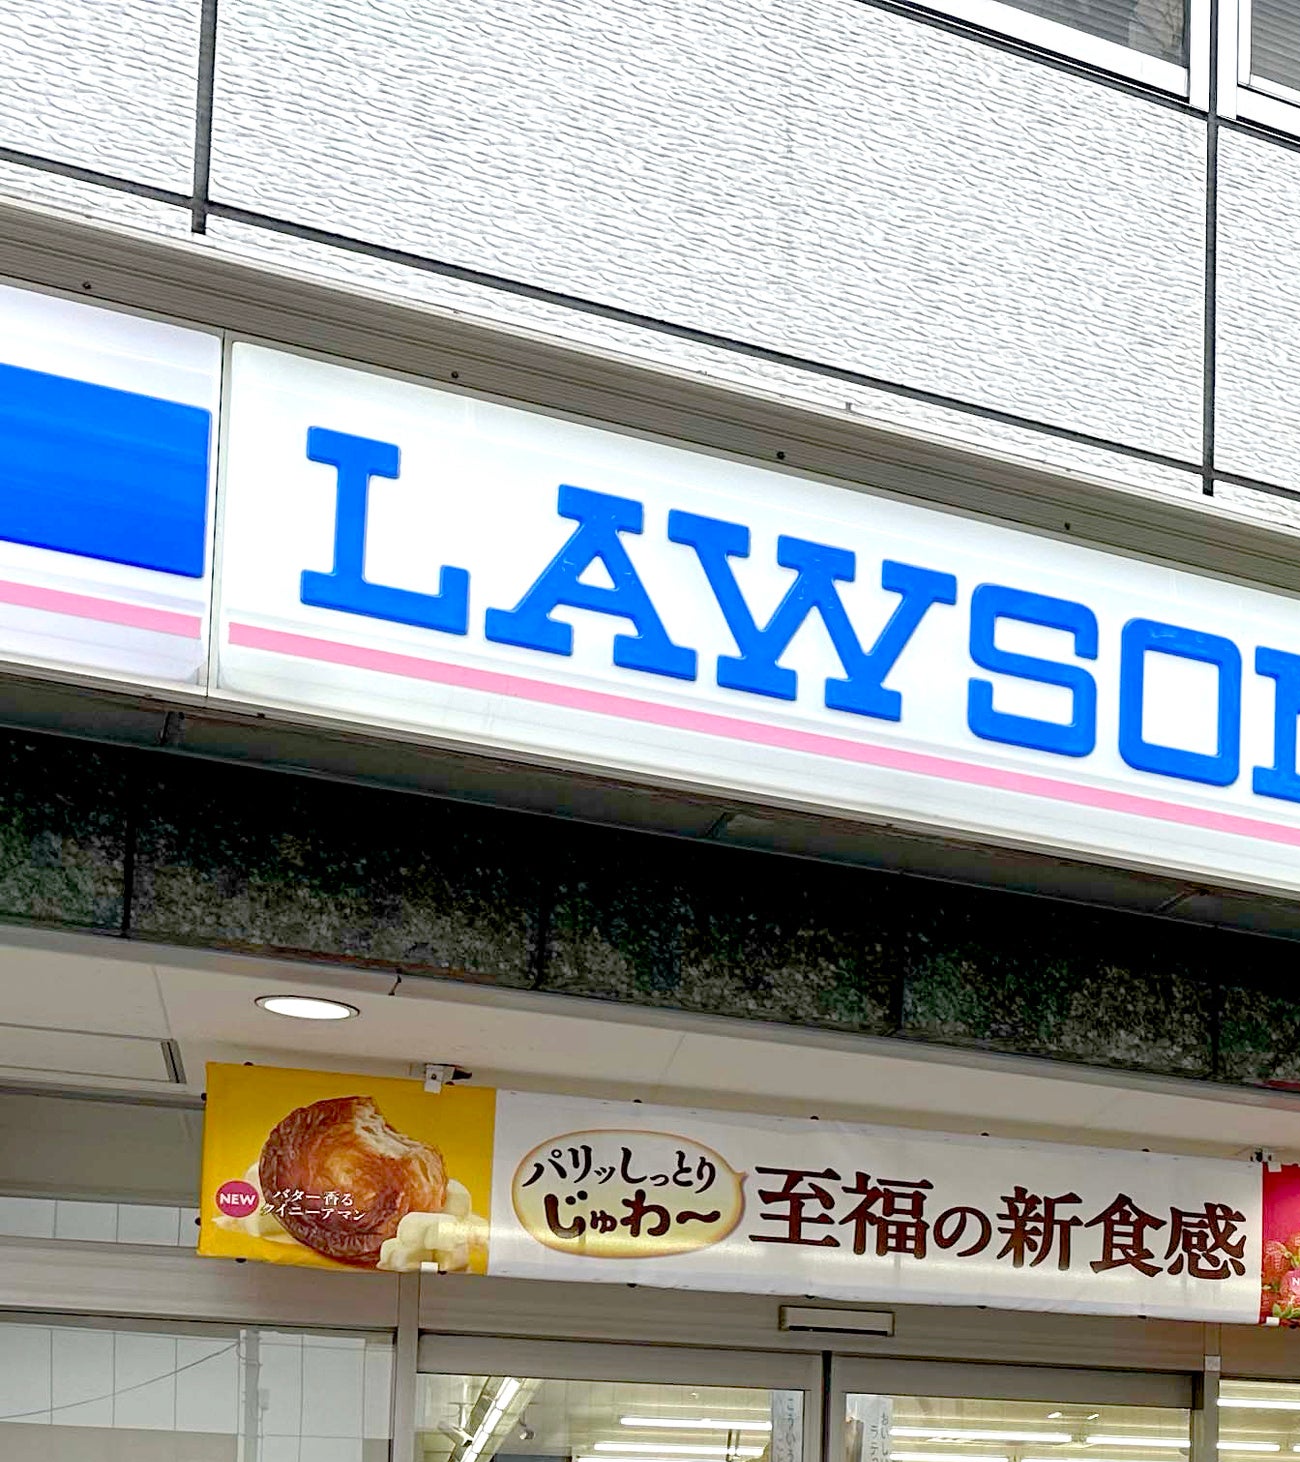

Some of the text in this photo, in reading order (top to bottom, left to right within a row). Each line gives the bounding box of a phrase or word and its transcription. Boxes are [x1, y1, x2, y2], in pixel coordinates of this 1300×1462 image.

[522, 1145, 716, 1194] パリッしっとり
[219, 1192, 256, 1205] NEW
[273, 1188, 353, 1206] バター香る
[261, 1202, 366, 1221] クイニーアマン
[749, 1165, 1247, 1280] 至福の新食感
